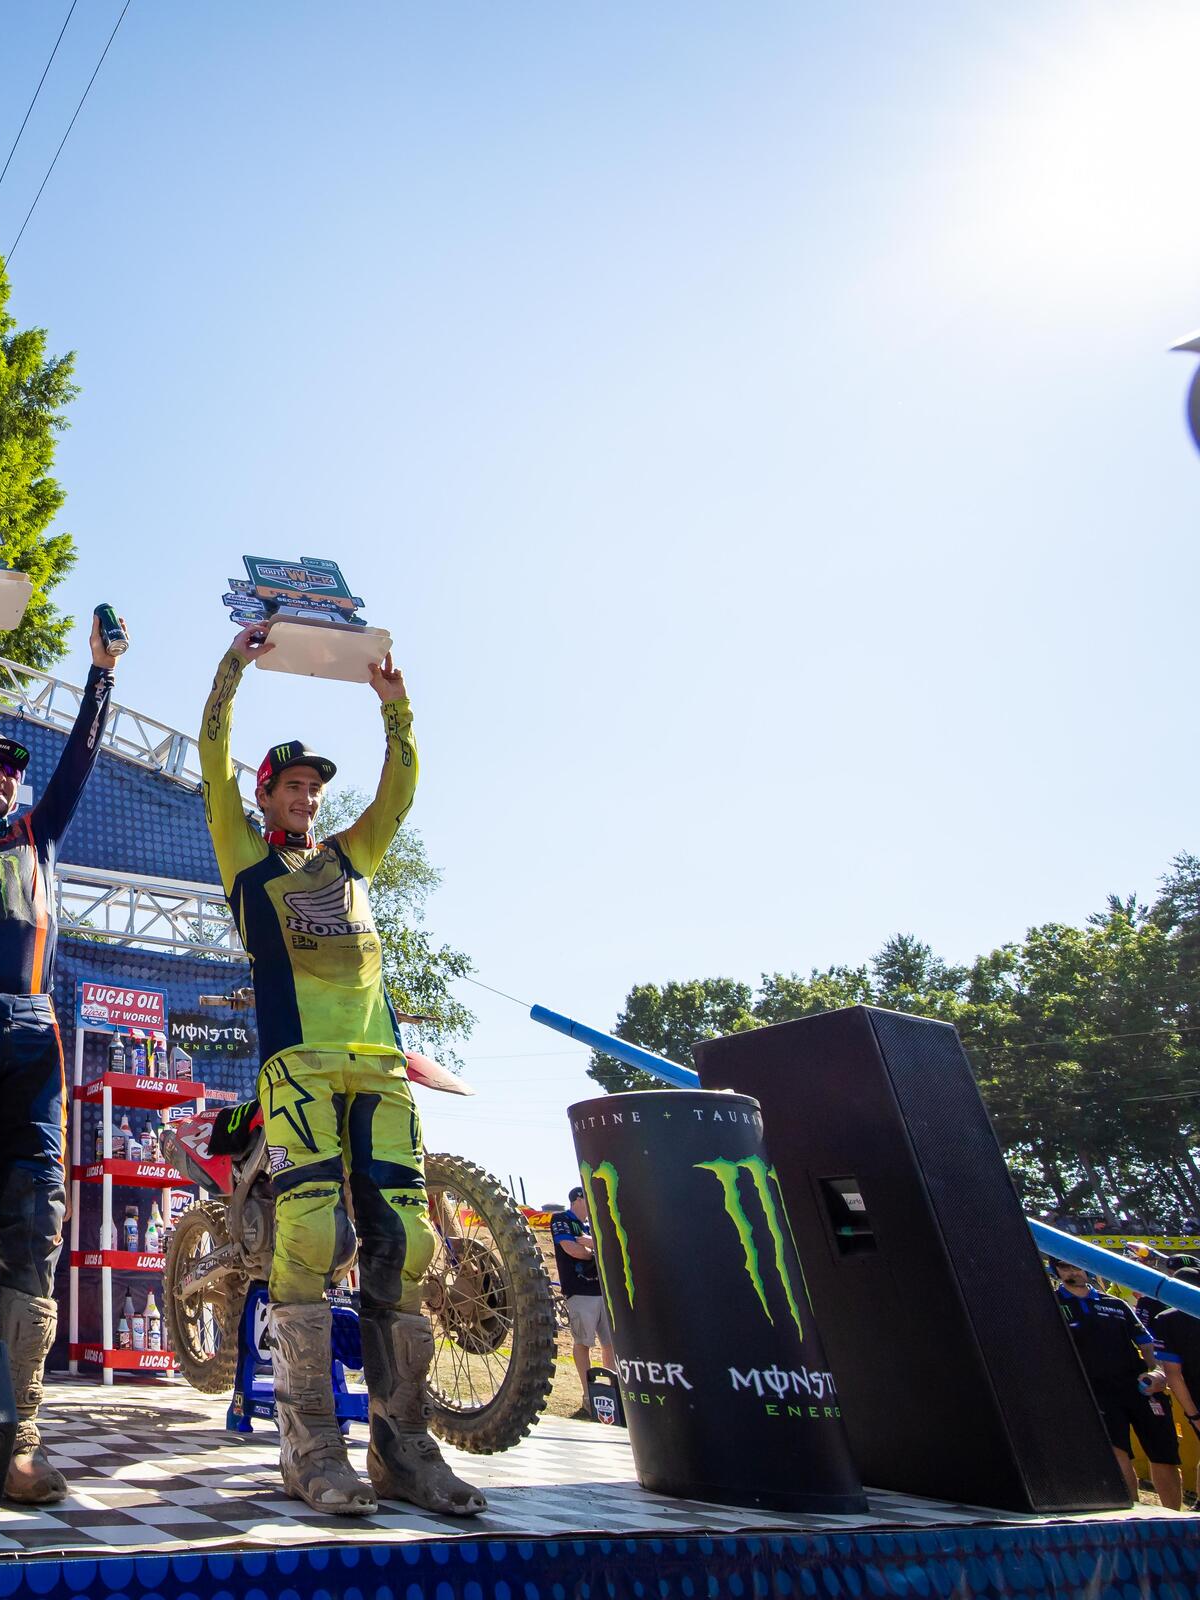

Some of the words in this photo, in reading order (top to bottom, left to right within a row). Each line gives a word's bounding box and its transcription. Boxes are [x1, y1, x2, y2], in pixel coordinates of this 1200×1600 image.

[276, 596, 309, 606] SECOND
[310, 601, 337, 609] PLACE
[286, 916, 376, 937] HONDA
[86, 986, 135, 1008] LUCAS
[137, 994, 162, 1010] OIL
[110, 1010, 121, 1019] IT
[122, 1011, 162, 1025] WORKS!
[136, 1079, 164, 1091] LUCAS
[165, 1083, 179, 1093] OIL
[86, 1167, 100, 1178] LUCAS
[137, 1165, 166, 1178] LUCAS
[167, 1168, 183, 1180] OIL
[271, 1160, 294, 1174] NDA
[171, 1196, 190, 1210] 00%
[85, 1254, 98, 1265] LUCAS
[137, 1256, 166, 1269] LUCAS
[84, 1348, 99, 1362] LUCAS
[139, 1355, 170, 1368] LUCAS
